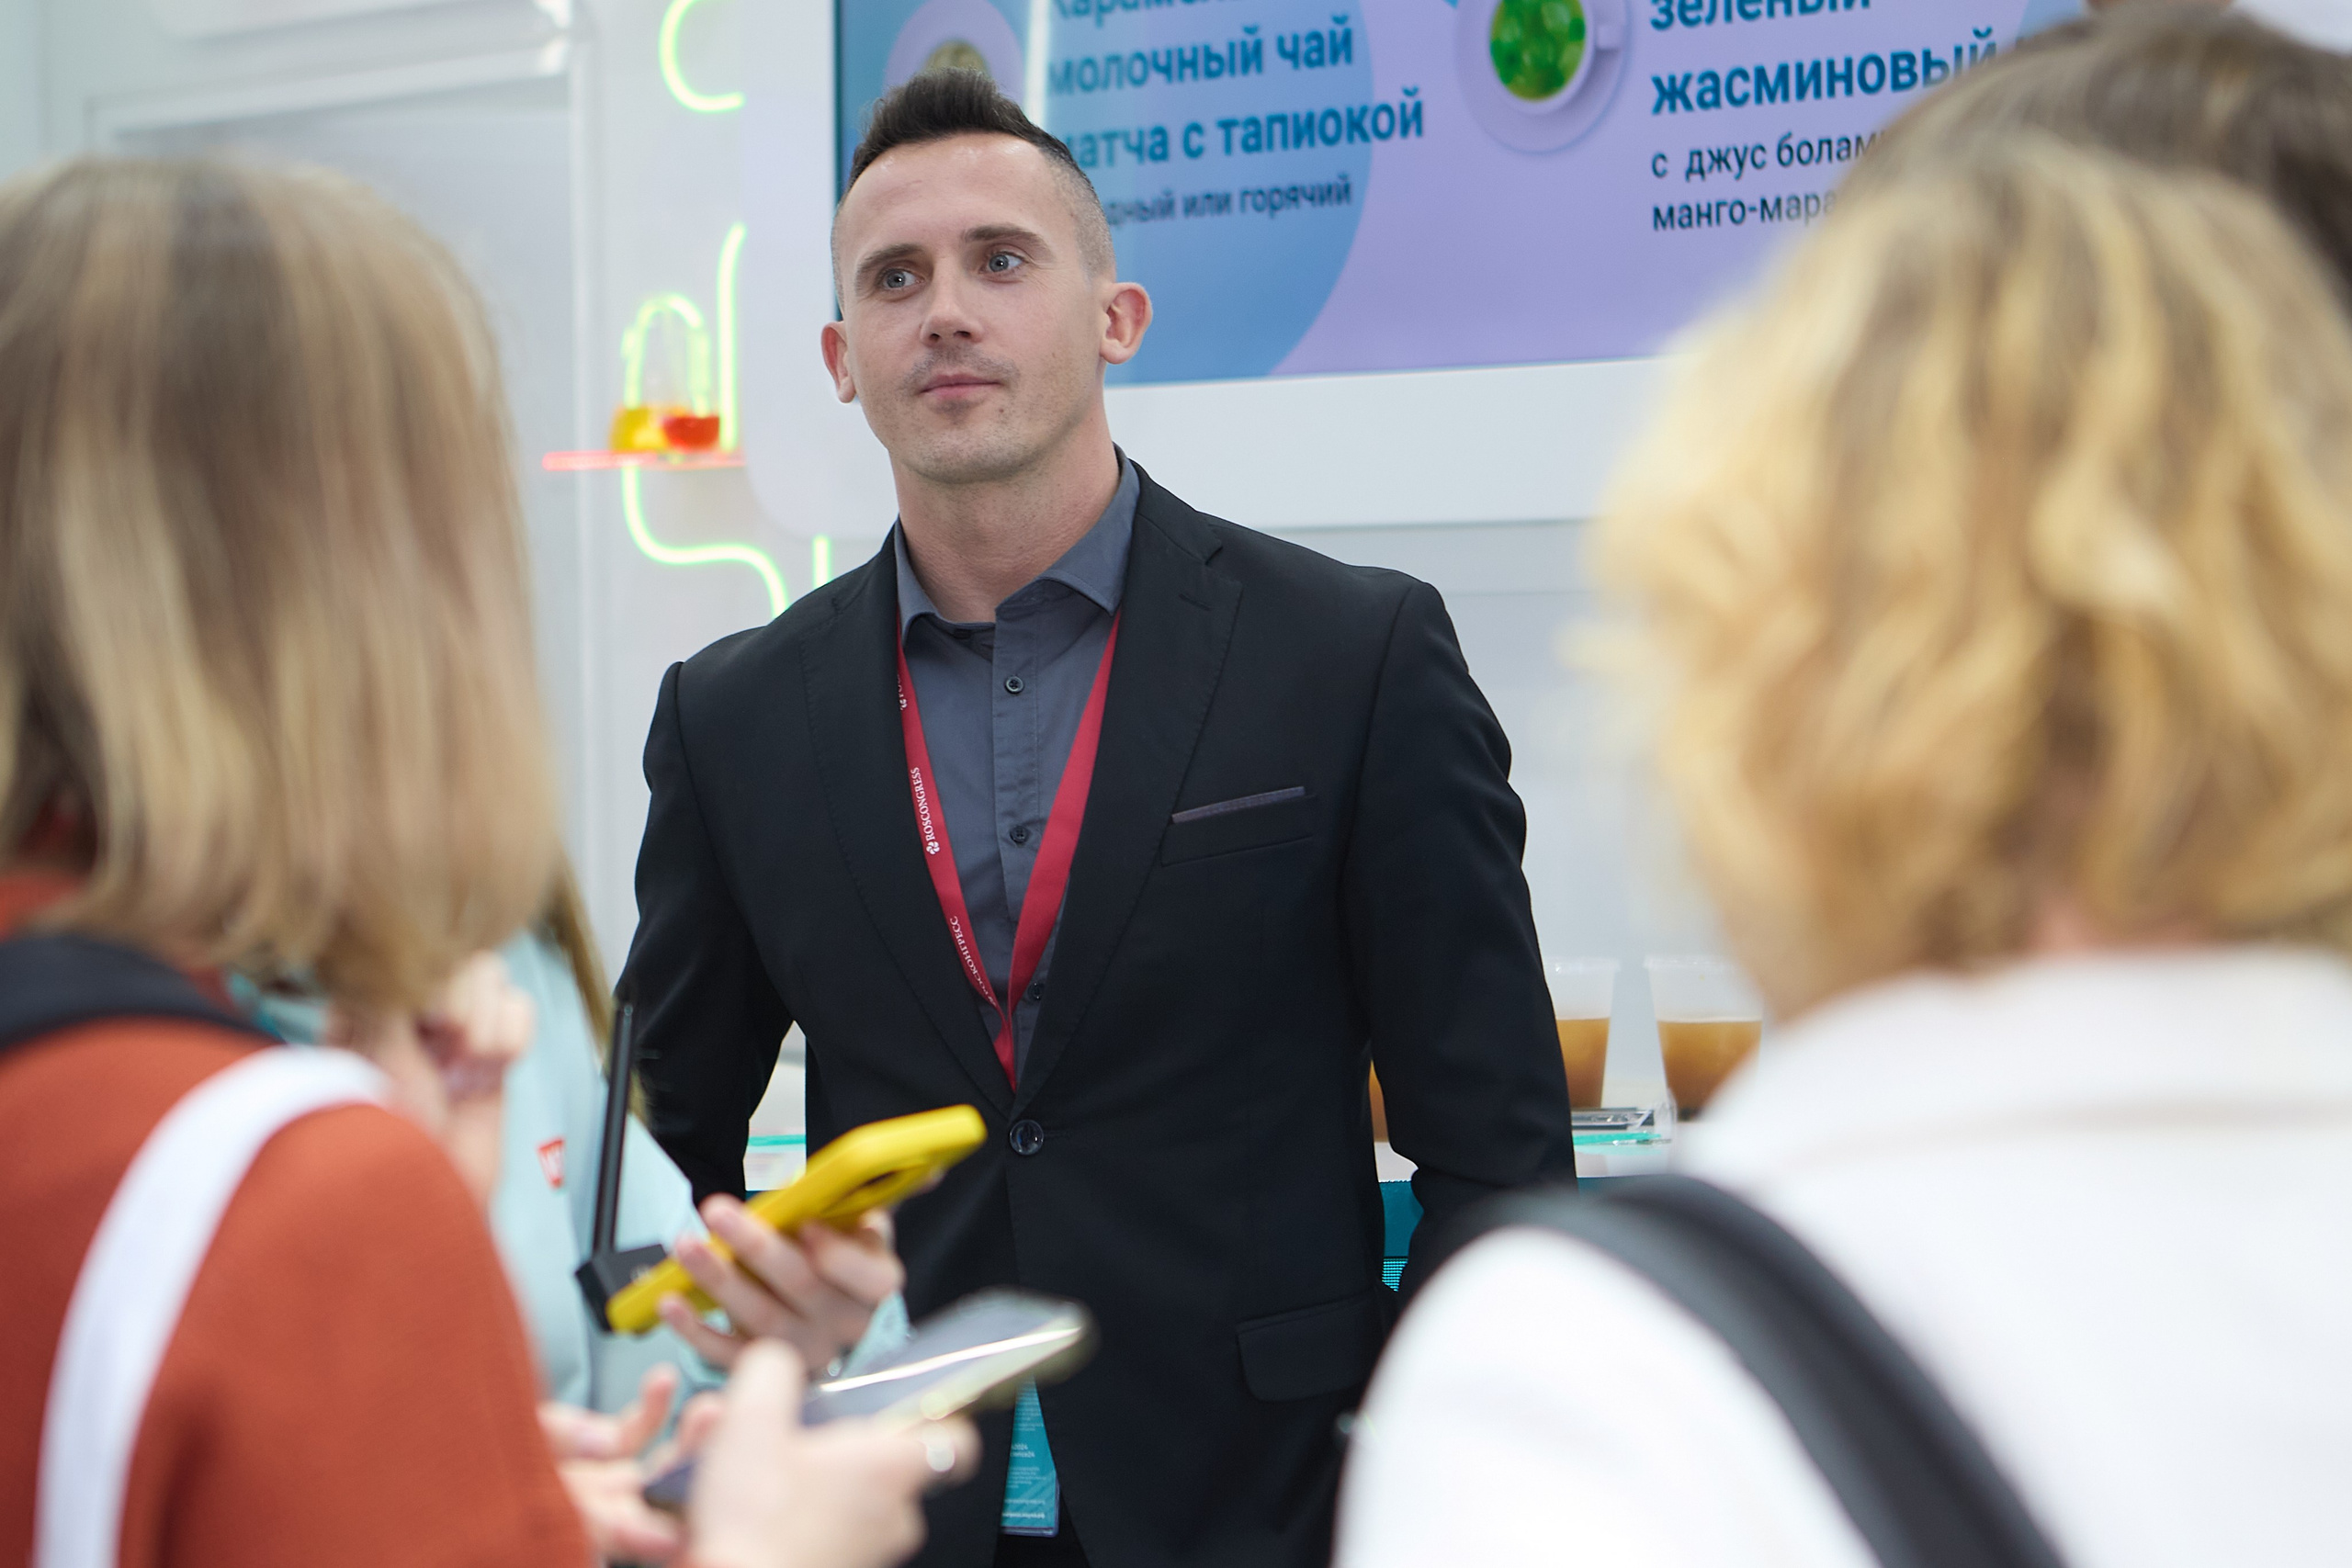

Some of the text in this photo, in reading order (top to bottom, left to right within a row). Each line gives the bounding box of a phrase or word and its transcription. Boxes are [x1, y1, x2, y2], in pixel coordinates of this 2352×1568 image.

[1650, 0, 1871, 31] зеле
[1048, 15, 1353, 95] молочный чай
[1651, 26, 1996, 115] жасминовый
[1066, 86, 1424, 169] атча с тапиокой
[1652, 131, 1886, 182] с джус болам
[1183, 191, 1232, 219] или
[1240, 172, 1352, 220] горячий
[1653, 189, 1840, 231] манго-мара
[910, 767, 936, 842] ROSCONGRESS
